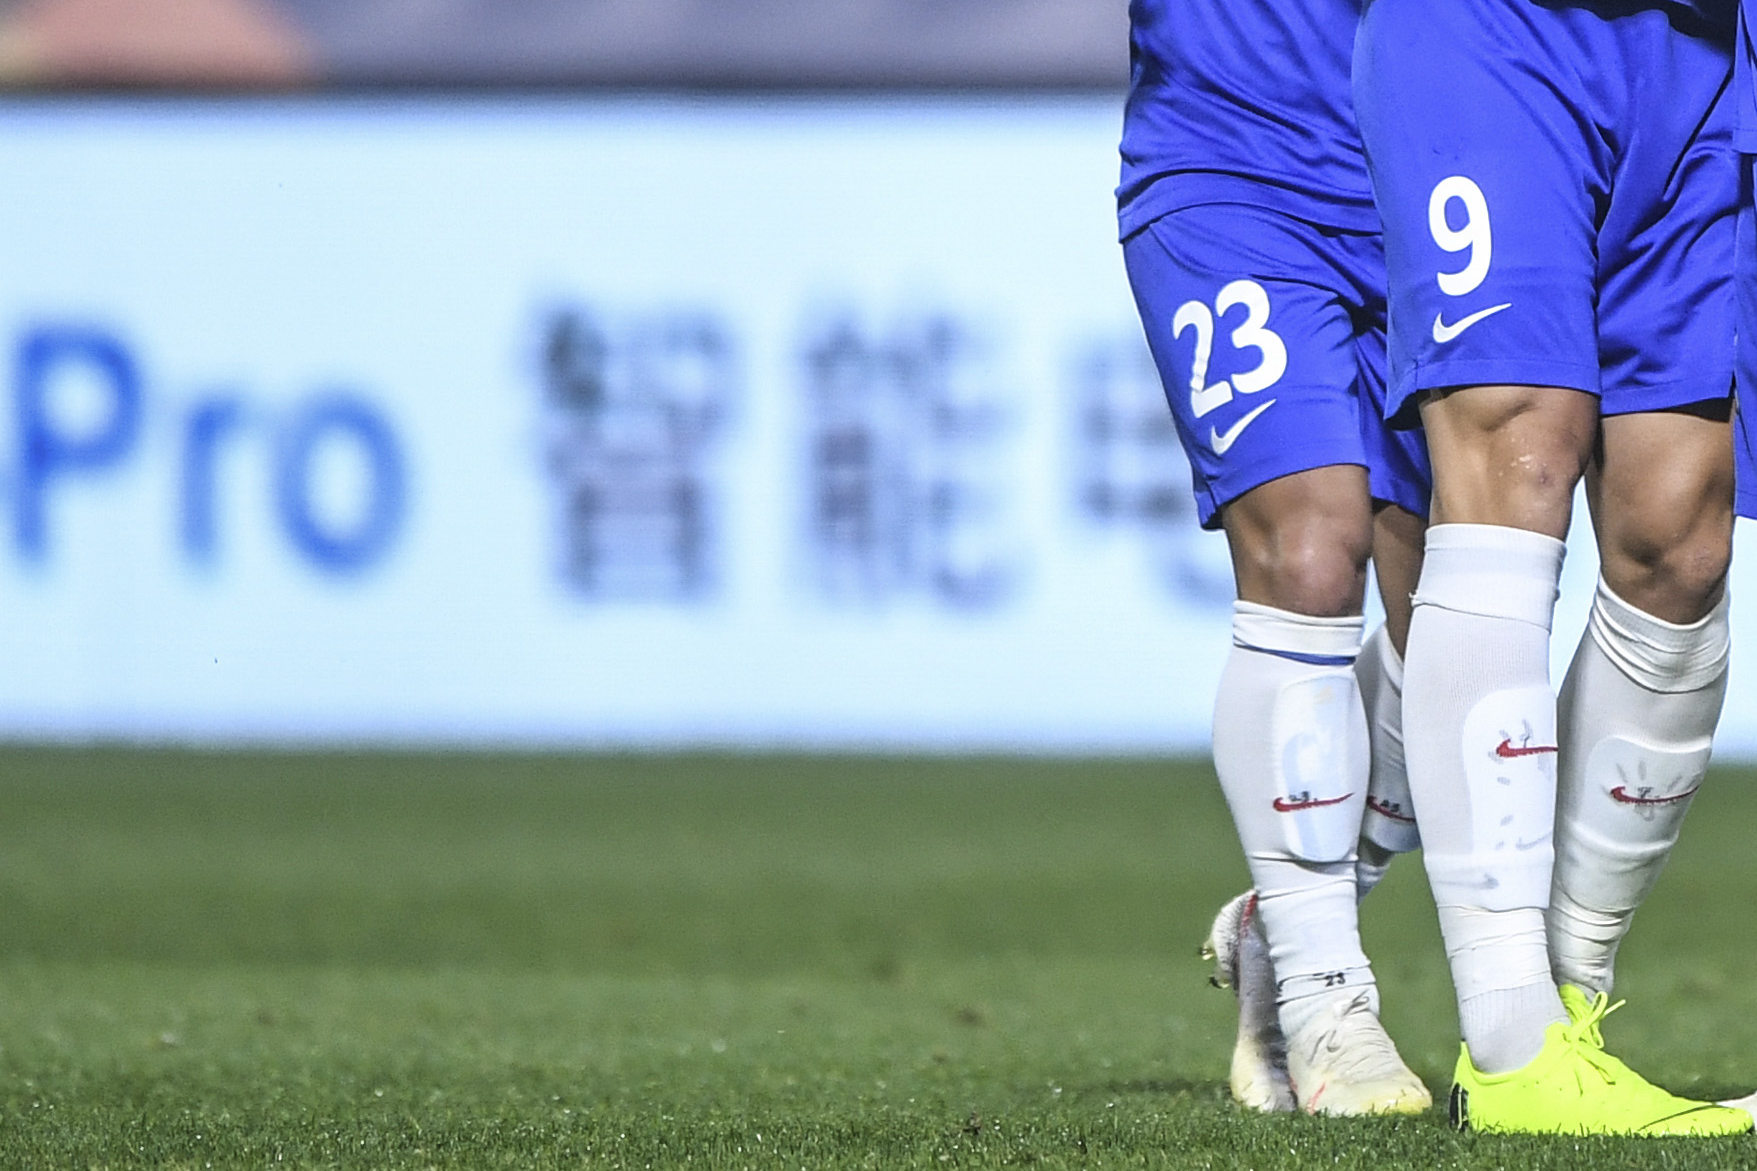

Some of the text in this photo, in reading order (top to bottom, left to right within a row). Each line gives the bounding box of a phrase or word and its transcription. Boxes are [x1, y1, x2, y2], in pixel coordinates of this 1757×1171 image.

[1428, 175, 1493, 297] 9
[1172, 279, 1288, 419] 23
[14, 316, 412, 578] Pro
